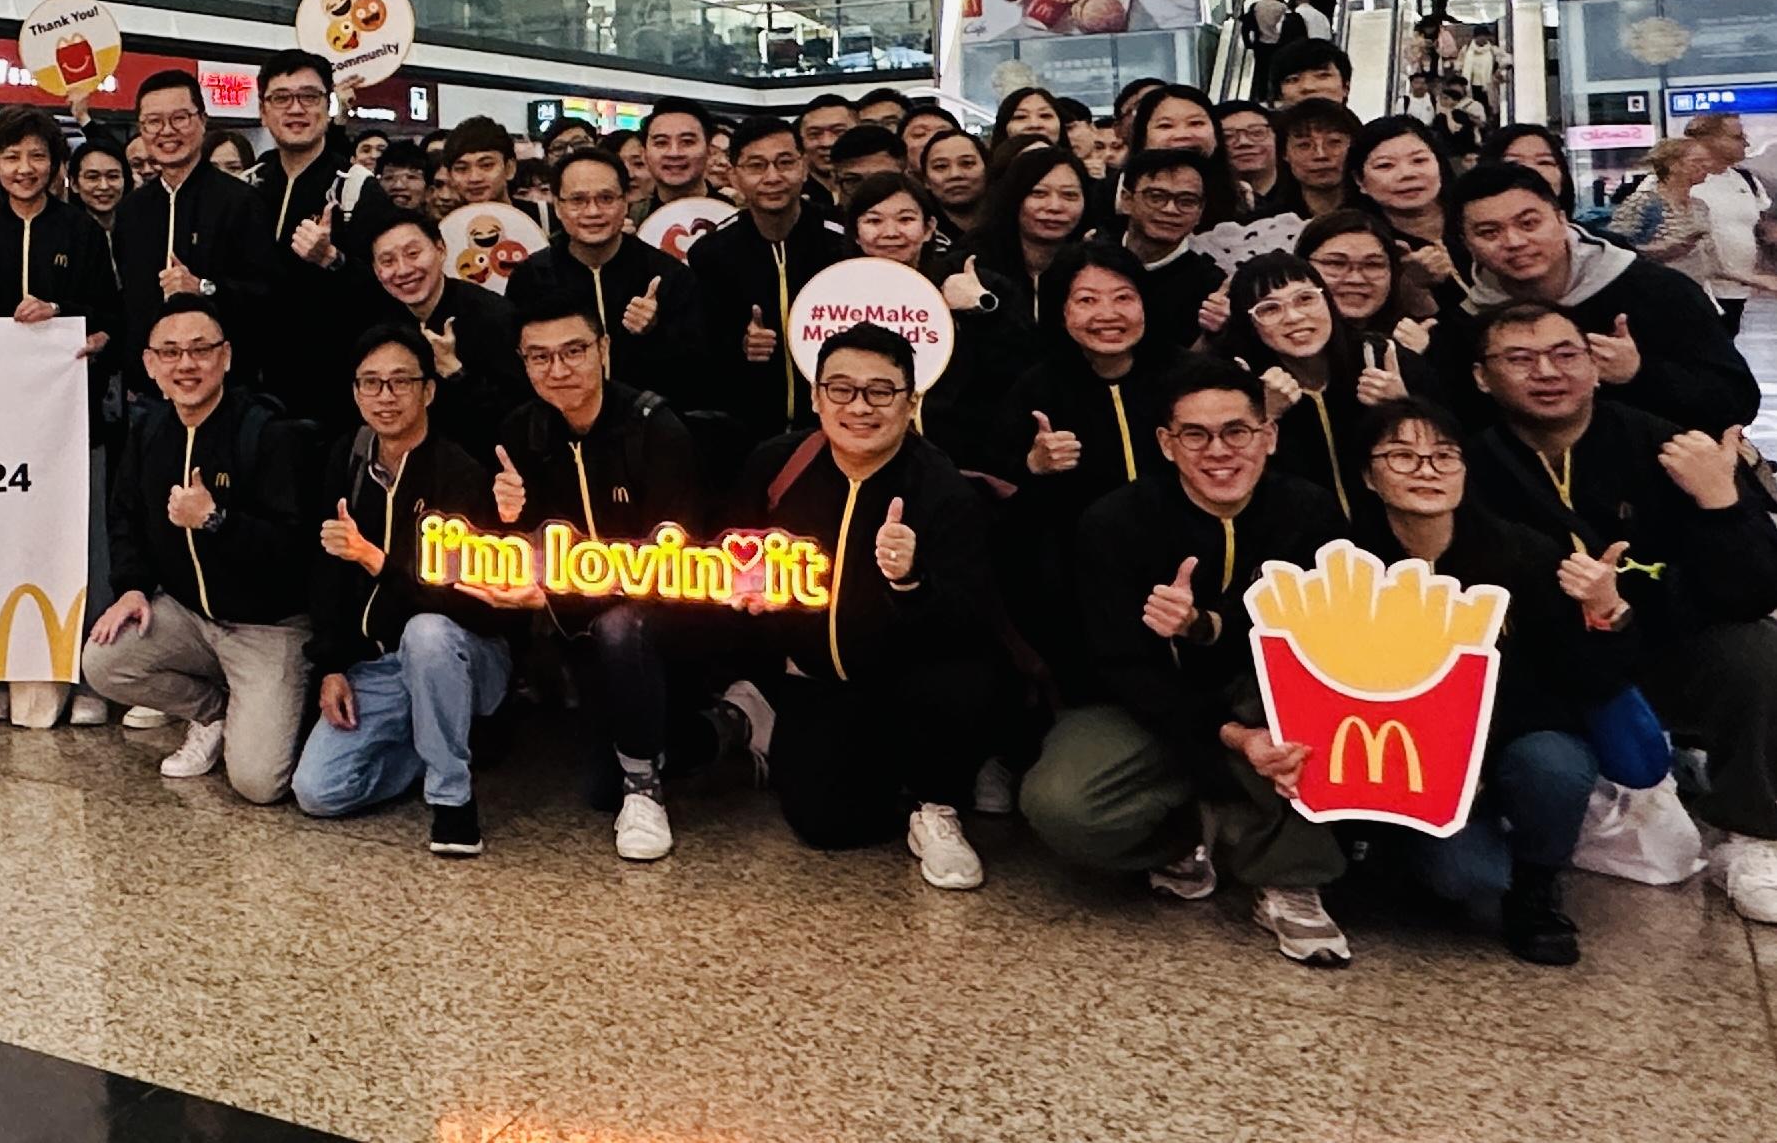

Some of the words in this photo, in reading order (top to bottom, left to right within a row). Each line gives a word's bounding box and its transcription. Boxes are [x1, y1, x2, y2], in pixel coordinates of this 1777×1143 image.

[28, 15, 71, 37] Thank
[71, 5, 100, 24] You!
[811, 304, 929, 324] #WeMake
[420, 514, 533, 587] i’m
